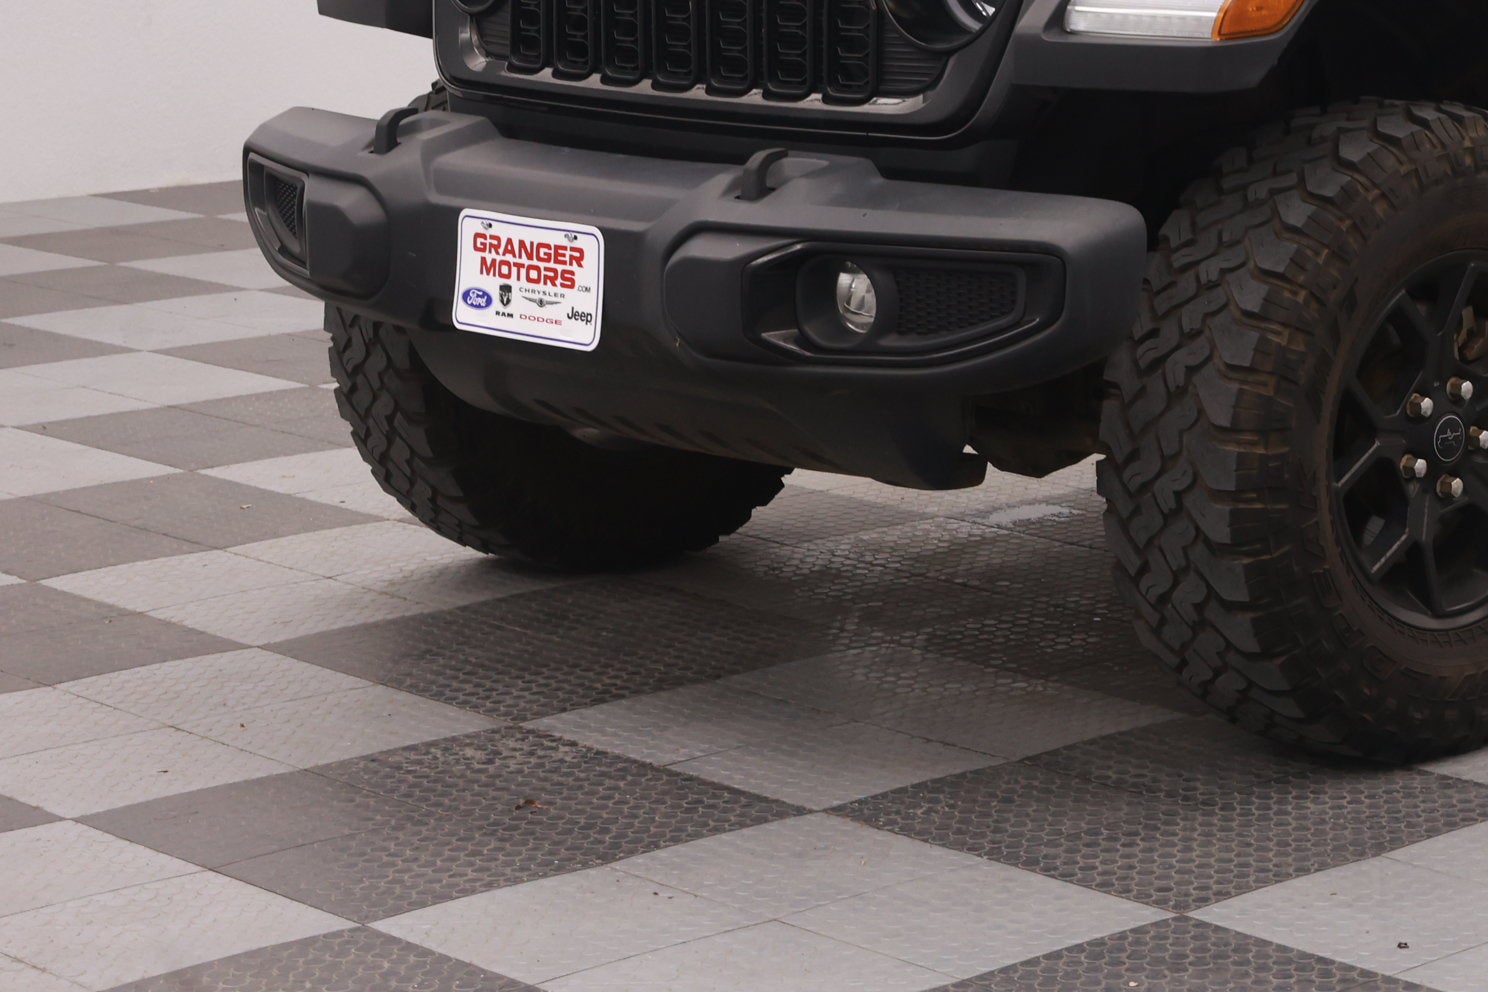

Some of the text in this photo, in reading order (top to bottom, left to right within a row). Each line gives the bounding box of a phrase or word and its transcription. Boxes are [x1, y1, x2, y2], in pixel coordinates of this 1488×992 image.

[473, 232, 585, 268] GRANGER
[479, 256, 576, 289] MOTORS
[518, 286, 566, 300] CHRYSLER
[495, 310, 514, 319] RAM
[519, 313, 563, 326] DODGE
[566, 306, 593, 326] Jeep
